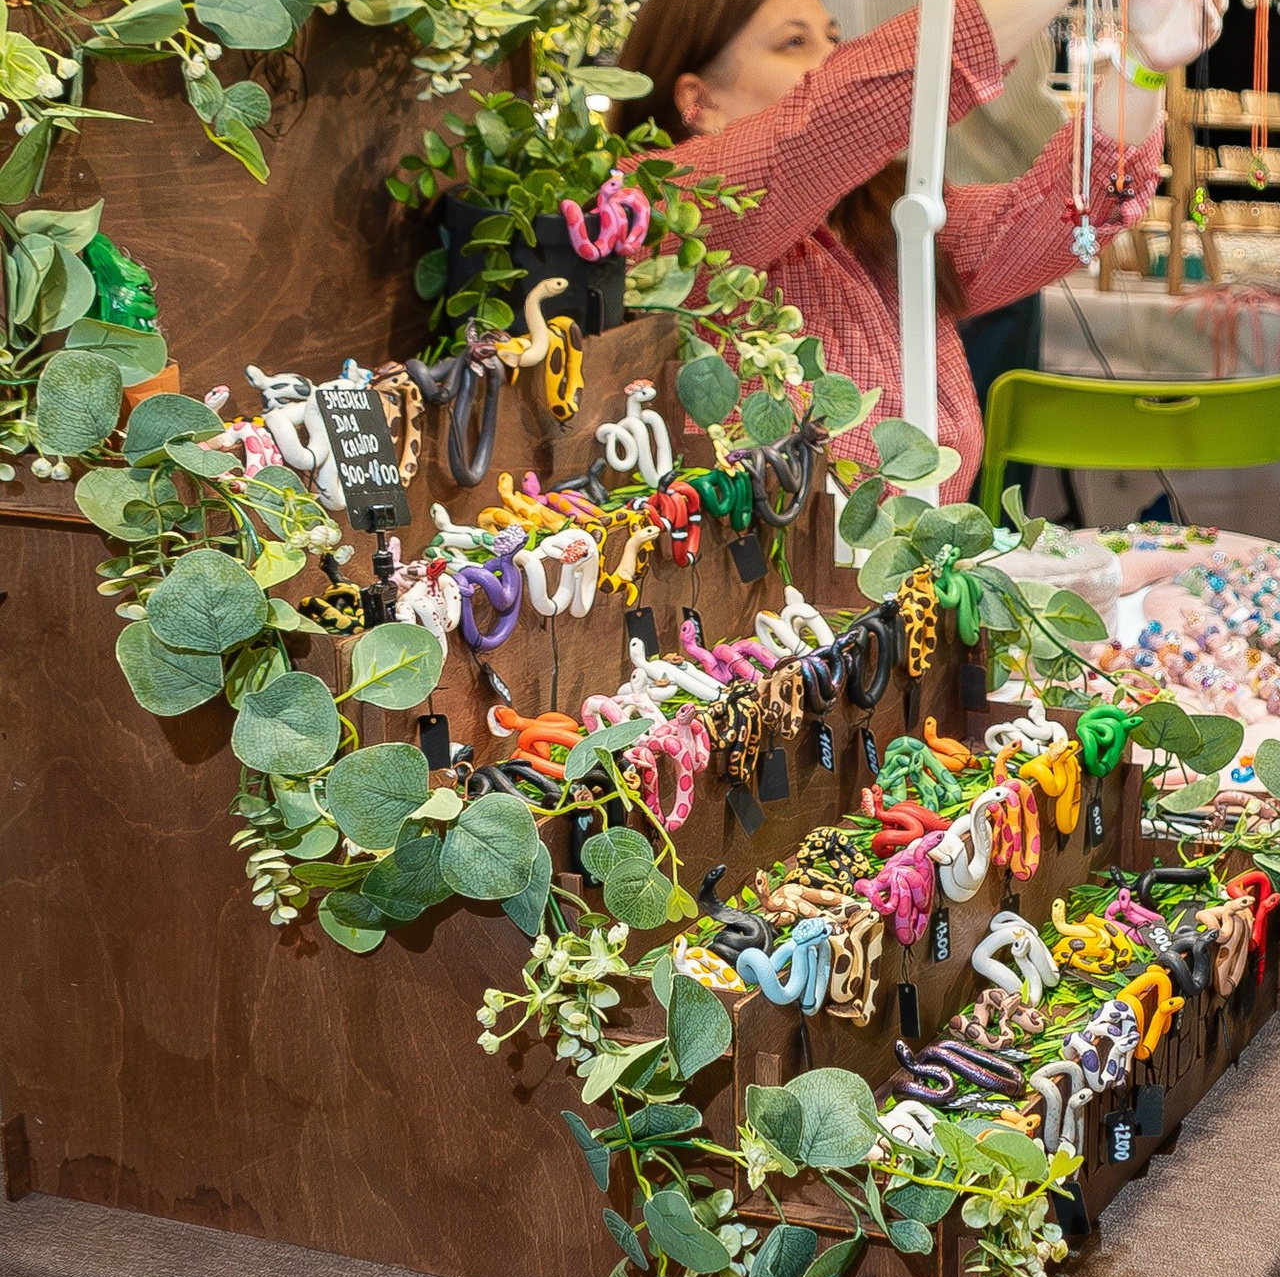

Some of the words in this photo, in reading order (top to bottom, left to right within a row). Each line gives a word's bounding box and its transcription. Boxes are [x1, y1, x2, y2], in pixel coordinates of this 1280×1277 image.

[331, 413, 360, 434] ДЛЯ
[340, 432, 380, 459] КАШПО
[819, 732, 833, 770] 1100
[936, 921, 949, 960] 1300
[1113, 1123, 1132, 1161] 1200
